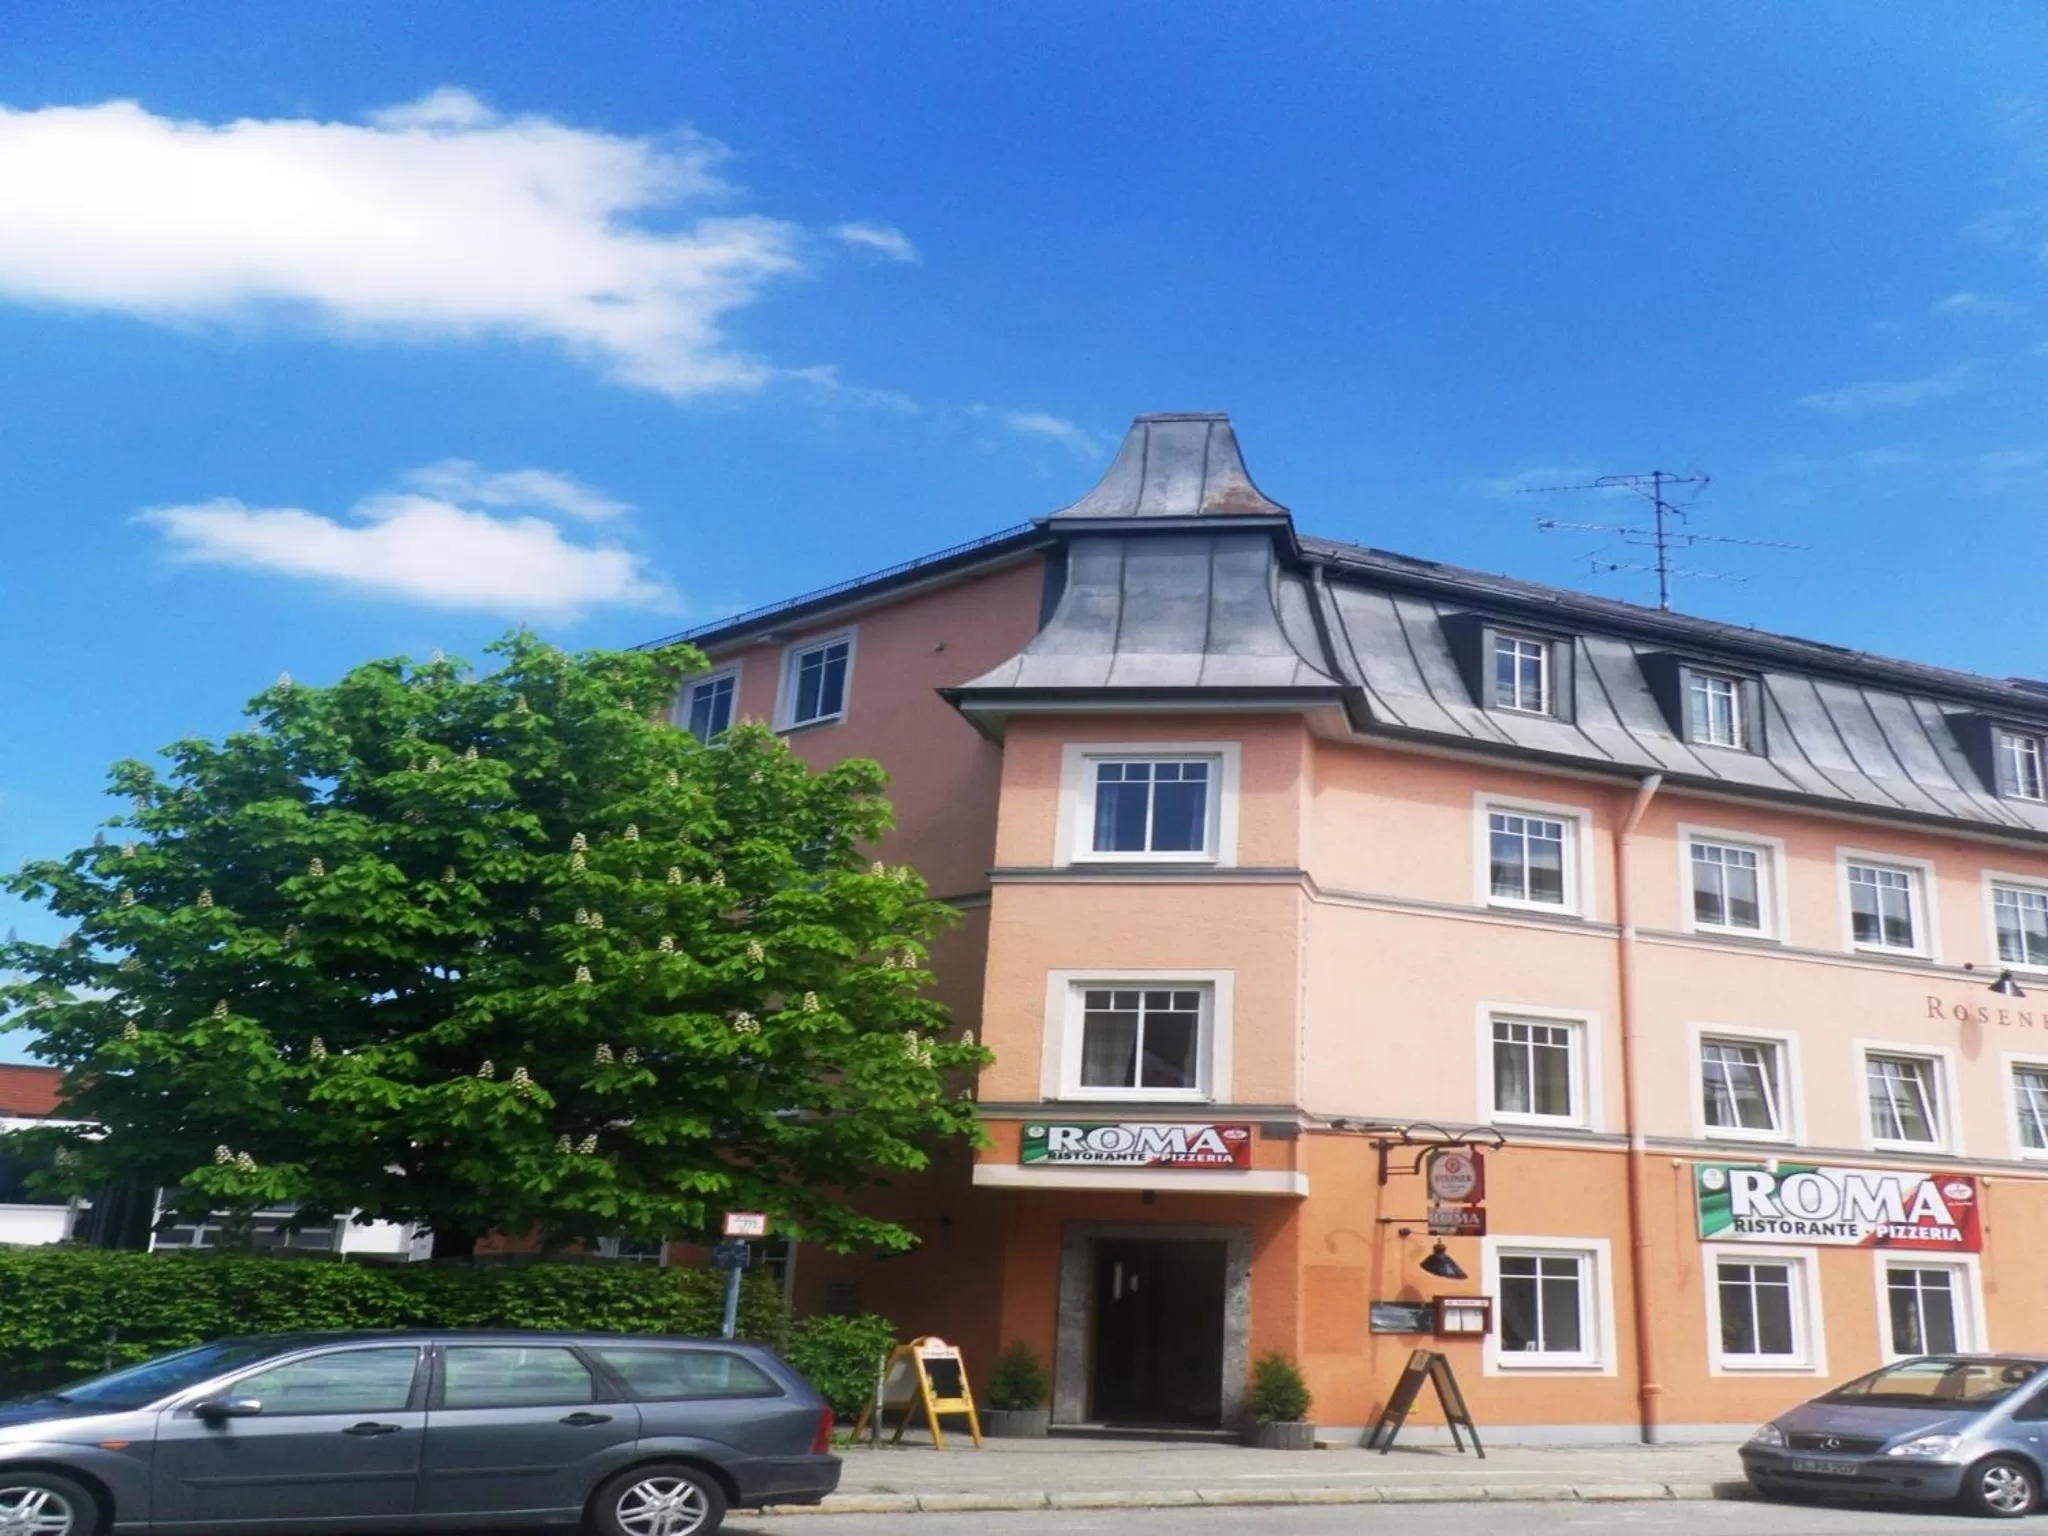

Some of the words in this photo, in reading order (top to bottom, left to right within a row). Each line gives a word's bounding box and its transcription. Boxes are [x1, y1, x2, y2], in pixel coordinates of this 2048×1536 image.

[1048, 1126, 1229, 1153] ROMA
[1048, 1152, 1145, 1163] RISTORANTE
[1162, 1153, 1234, 1164] PIZZERIA
[1727, 1168, 1956, 1225] ROMA
[1733, 1218, 1859, 1237] RISTORANTE
[1876, 1223, 1963, 1242] PIZZERIA
